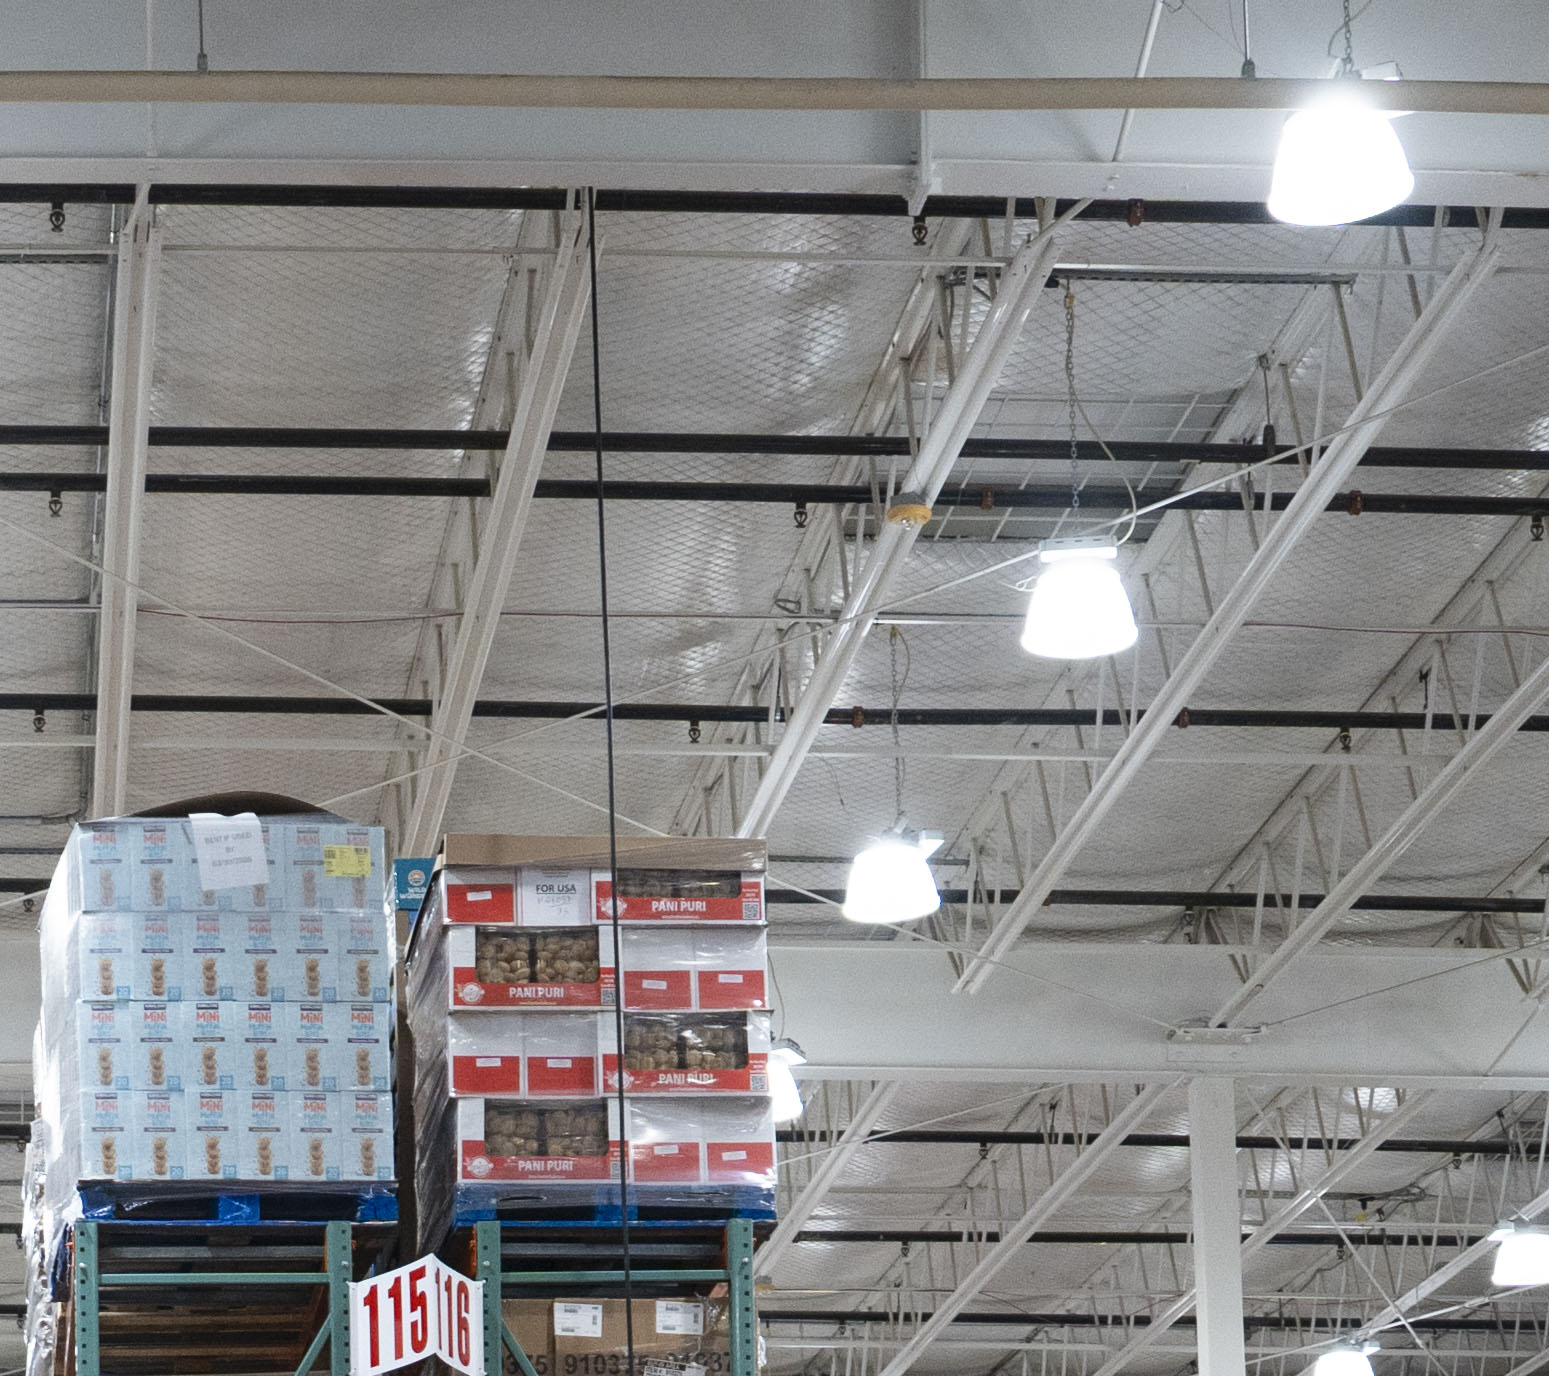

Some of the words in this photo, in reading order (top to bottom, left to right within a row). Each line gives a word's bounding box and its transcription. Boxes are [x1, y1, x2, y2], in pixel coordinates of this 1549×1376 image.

[536, 884, 554, 894] FOR
[557, 884, 576, 893] USA
[652, 901, 677, 912] PANI
[680, 901, 706, 912] PURI
[510, 987, 535, 999] PANI
[538, 987, 564, 999] PURI
[659, 1074, 685, 1084] PANI
[518, 1160, 544, 1171] PANI
[547, 1160, 573, 1171] PURI
[363, 1265, 428, 1368] 115
[435, 1267, 470, 1367] 116
